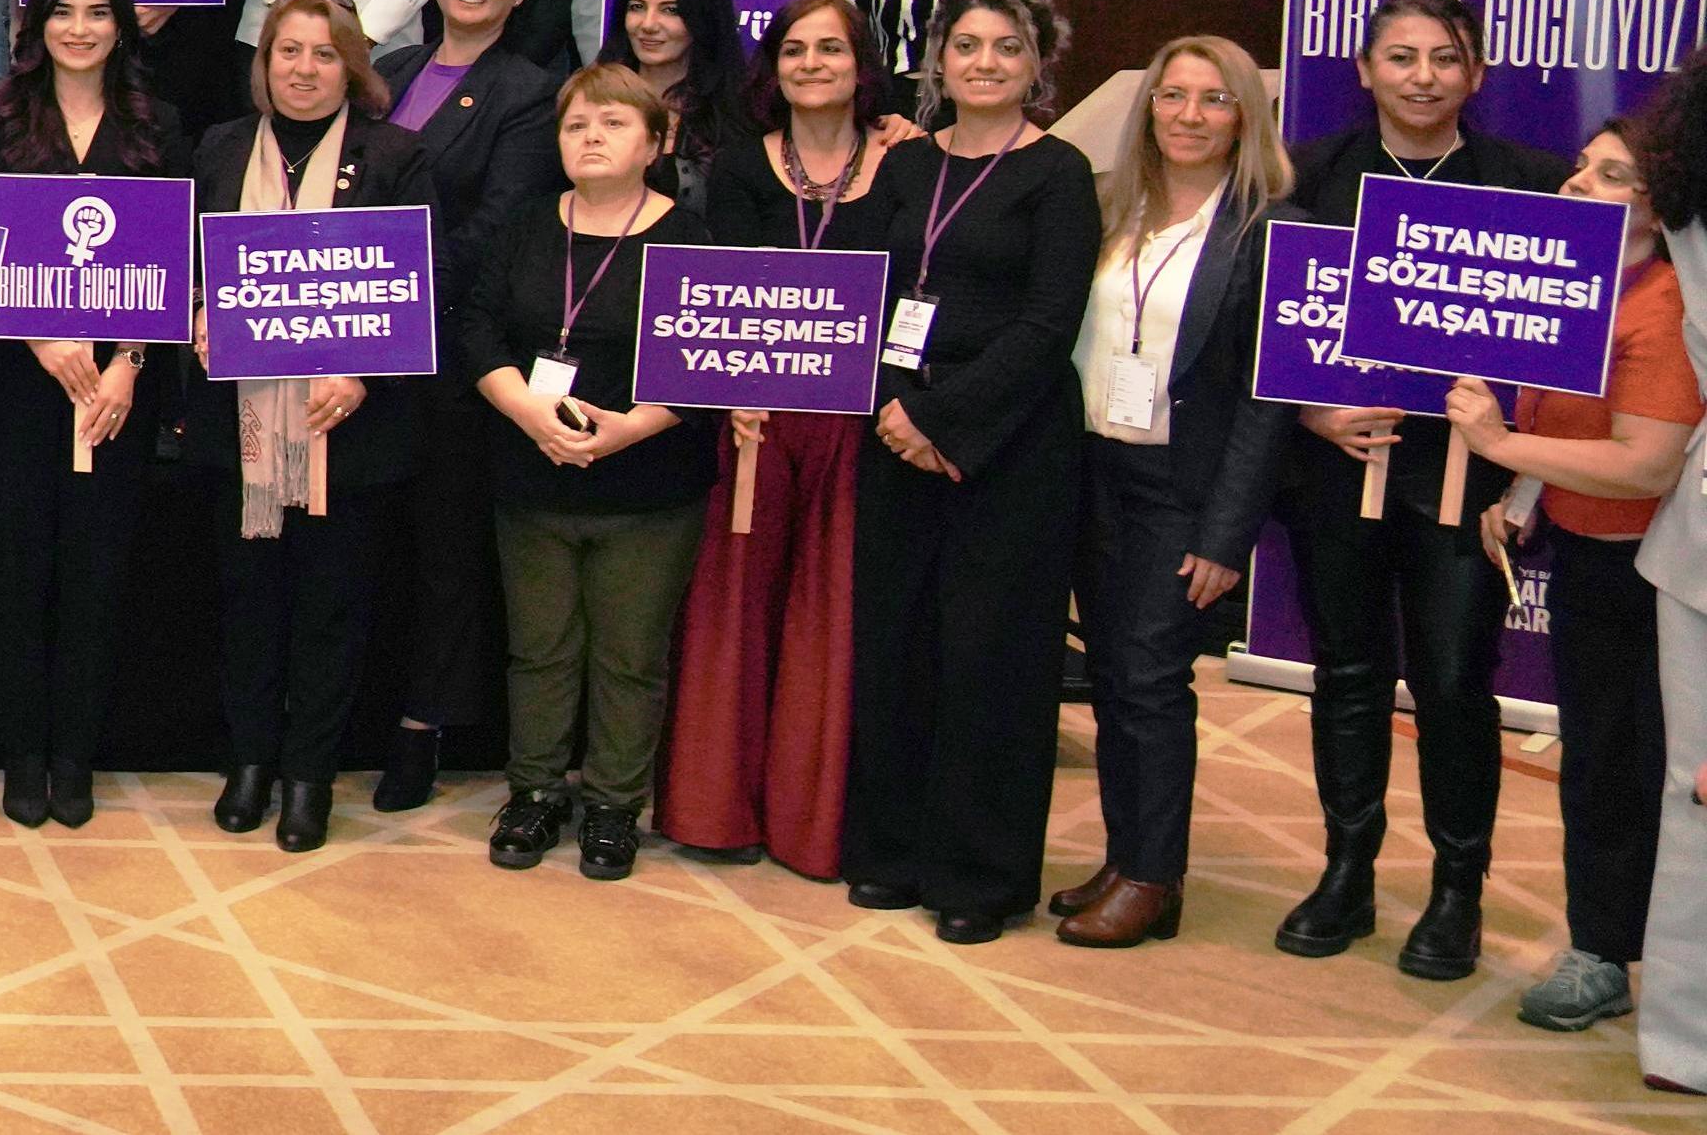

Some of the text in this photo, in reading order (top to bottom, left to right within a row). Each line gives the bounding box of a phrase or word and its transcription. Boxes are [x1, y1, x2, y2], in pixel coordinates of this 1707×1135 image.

[237, 244, 395, 275] İSTANBUL
[1395, 213, 1577, 268] İSTANBUL
[79, 262, 167, 318] GÜÇLÜYÜZ
[217, 270, 419, 310] SÖZLEŞMESİ
[679, 276, 845, 311] İSTANBUL
[1364, 251, 1603, 311] SÖZLEŞMESİ
[245, 313, 392, 345] YAŞATIR!
[652, 309, 868, 346] SÖZLEŞMESİ
[1393, 296, 1561, 345] YAŞATIR!
[680, 348, 833, 377] YAŞATIR!
